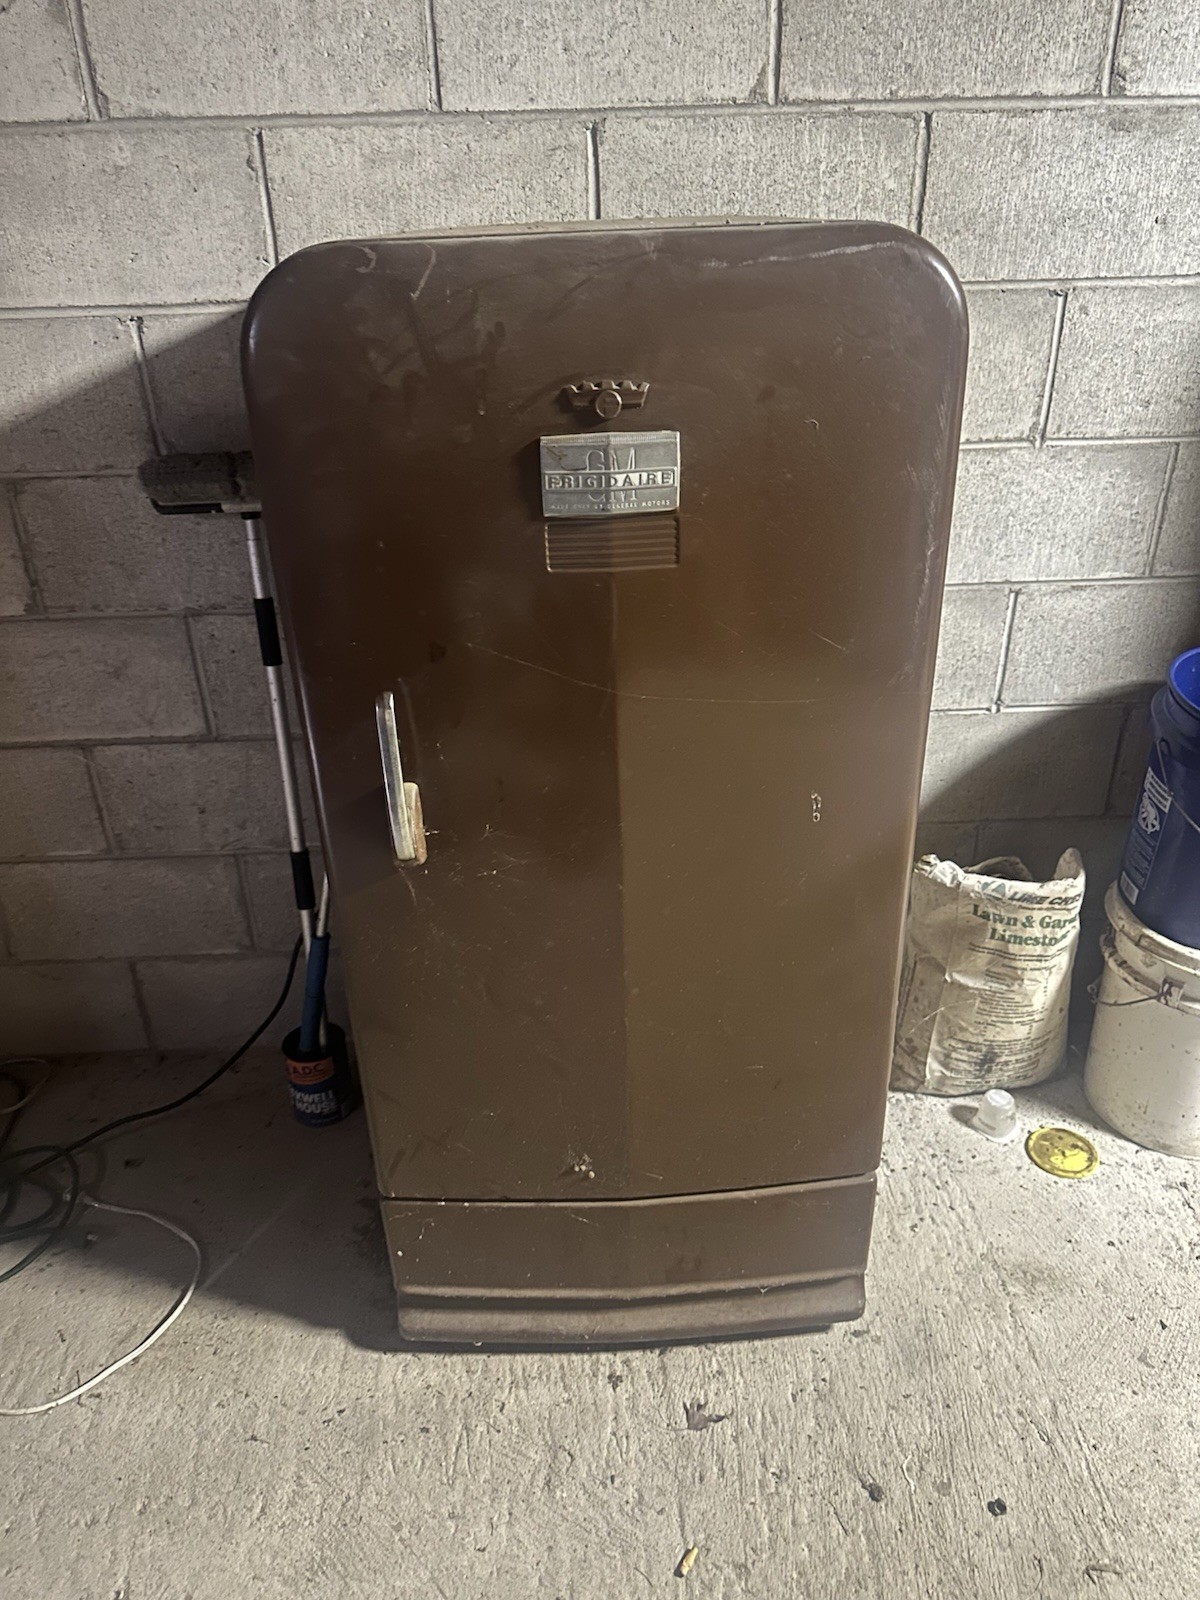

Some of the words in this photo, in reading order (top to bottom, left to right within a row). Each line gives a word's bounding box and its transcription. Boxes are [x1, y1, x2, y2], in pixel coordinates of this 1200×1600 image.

[549, 471, 674, 489] FRIGIDAIRE
[607, 501, 638, 510] GENERAL
[641, 499, 671, 508] MOTORS
[972, 903, 1019, 927] Lawn
[1021, 914, 1036, 929] &
